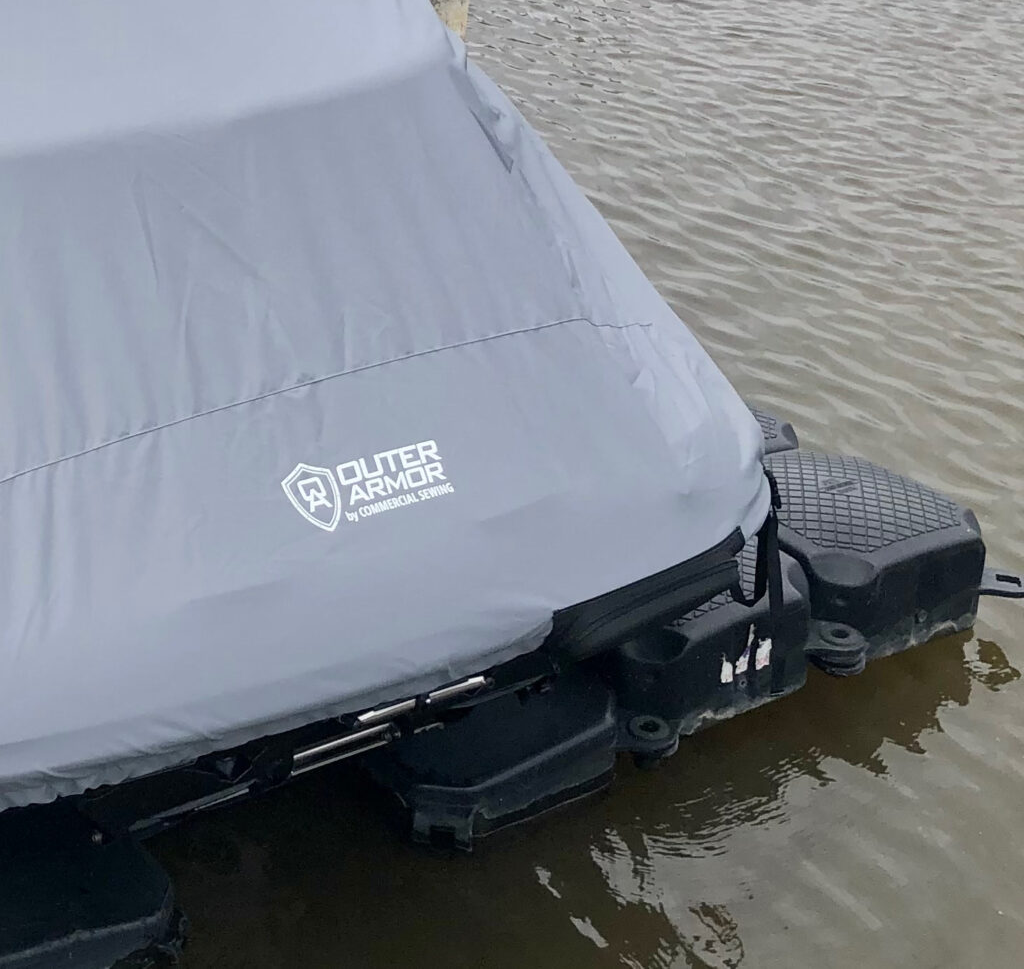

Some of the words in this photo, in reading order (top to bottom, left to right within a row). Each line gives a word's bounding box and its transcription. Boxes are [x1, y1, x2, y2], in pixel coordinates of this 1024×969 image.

[336, 439, 443, 486] OUTER
[349, 461, 447, 506] ARMOR
[345, 510, 360, 523] by
[359, 492, 420, 519] COMMERCIAL
[419, 482, 455, 503] SEWING
